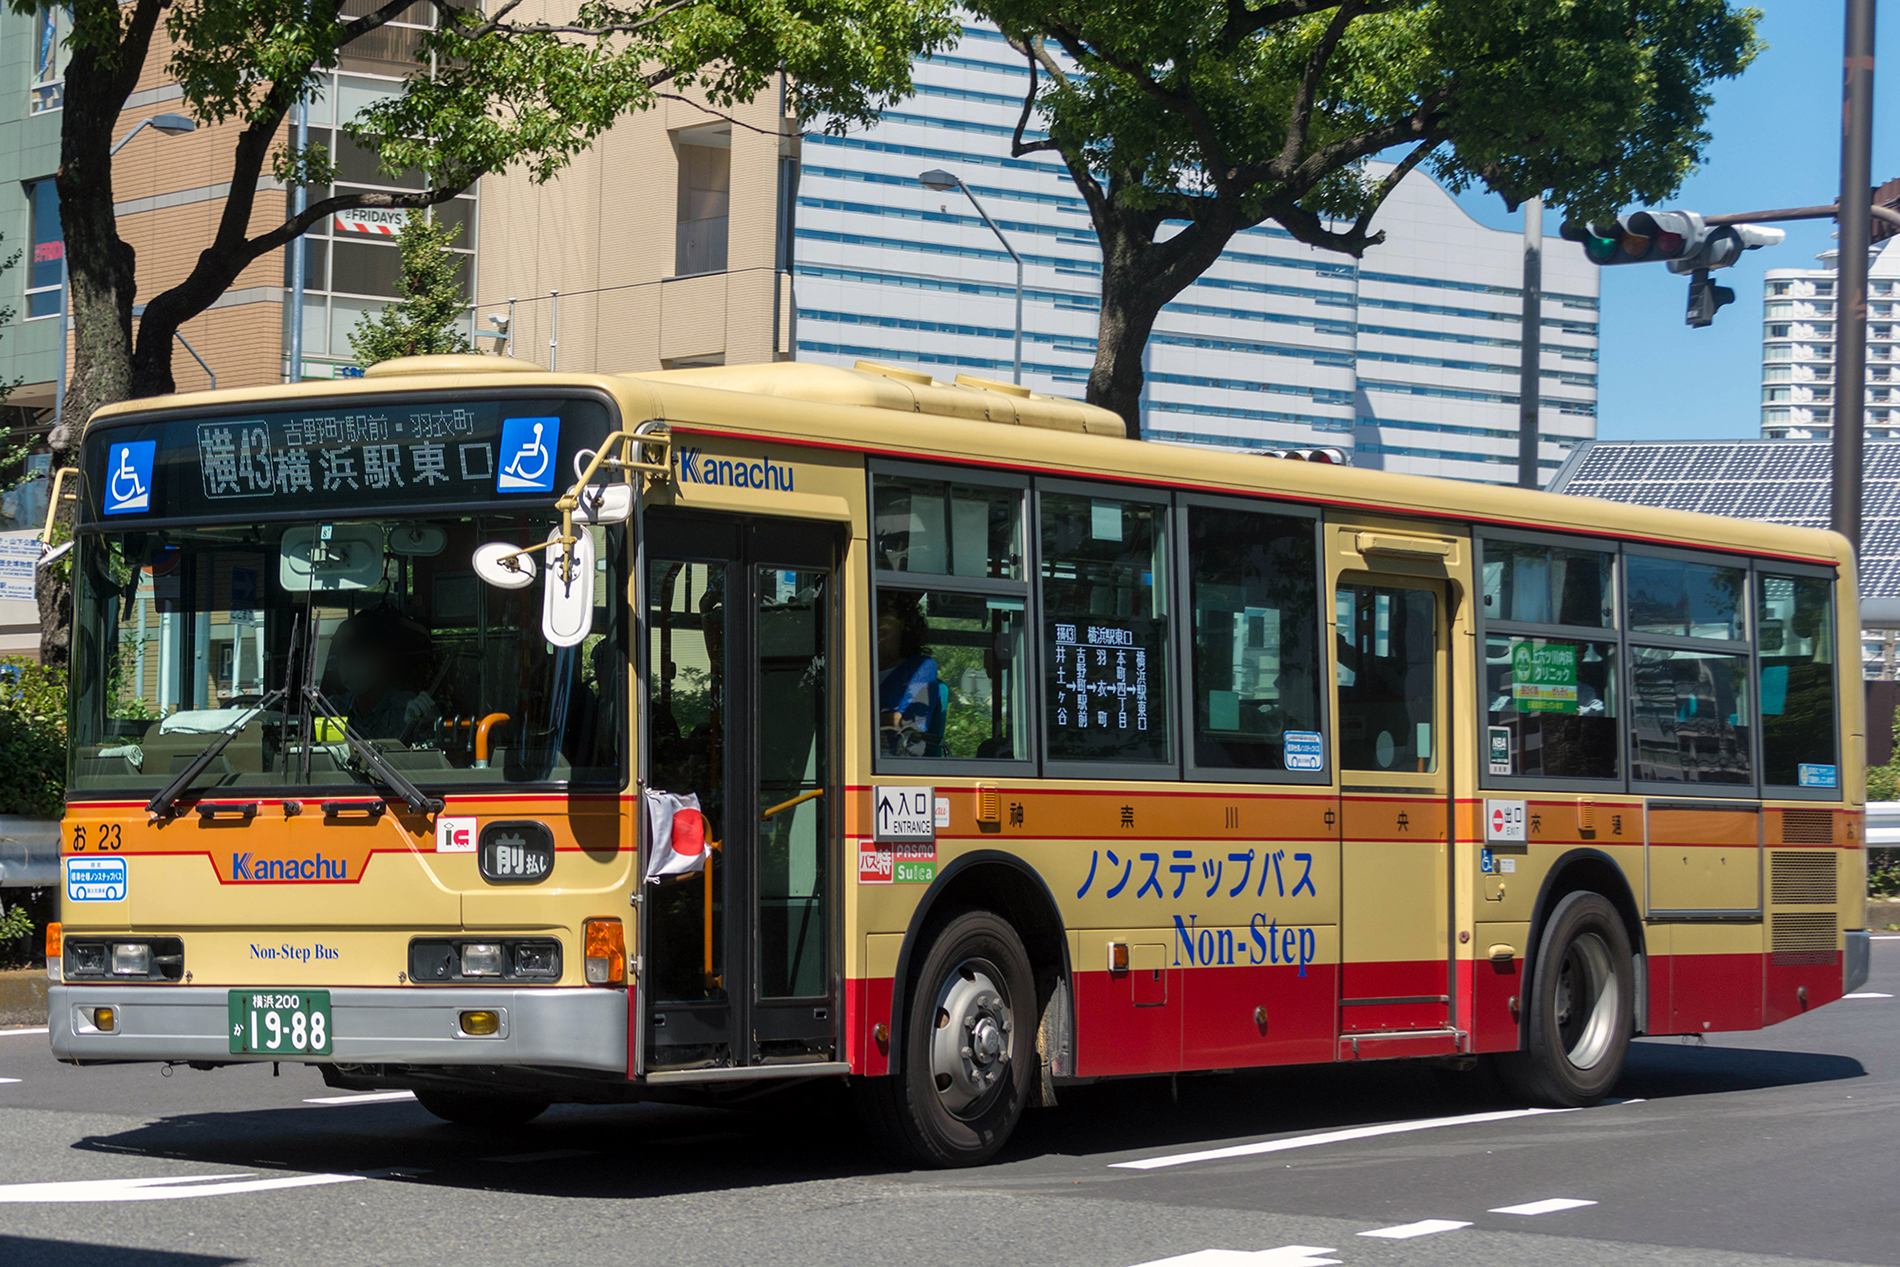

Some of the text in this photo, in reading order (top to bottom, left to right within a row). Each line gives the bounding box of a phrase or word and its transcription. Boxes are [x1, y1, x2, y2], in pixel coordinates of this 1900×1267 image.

[352, 209, 402, 225] FRIDAYS
[283, 409, 475, 446] 吉野町駅前・羽衣町
[273, 440, 493, 494] 横浜駅東口
[680, 446, 794, 491] Kanachu
[1087, 626, 1133, 645] 横浜駅東口
[1534, 667, 1570, 681] クリニック
[1076, 647, 1088, 728] 吉野町駅前
[1096, 649, 1108, 728] 羽衣町
[1116, 649, 1127, 729] 本町四丁目
[1136, 651, 1147, 730] 横浜駅東口
[898, 793, 926, 816] 入口
[1504, 807, 1521, 823] 出口
[73, 824, 121, 851] お 23
[893, 820, 930, 834] ENTRANCE
[1507, 826, 1520, 836] EXIT
[897, 844, 934, 858] PASMO
[232, 853, 346, 880] Kanachu
[898, 865, 933, 880] Suica
[1076, 848, 1316, 900] ノンステップバス
[250, 943, 339, 963] Non-Step Bus
[1172, 912, 1316, 977] Non-Step
[252, 994, 300, 1009] 横浜200
[233, 1023, 245, 1037] か
[251, 1011, 326, 1050] 19-88
